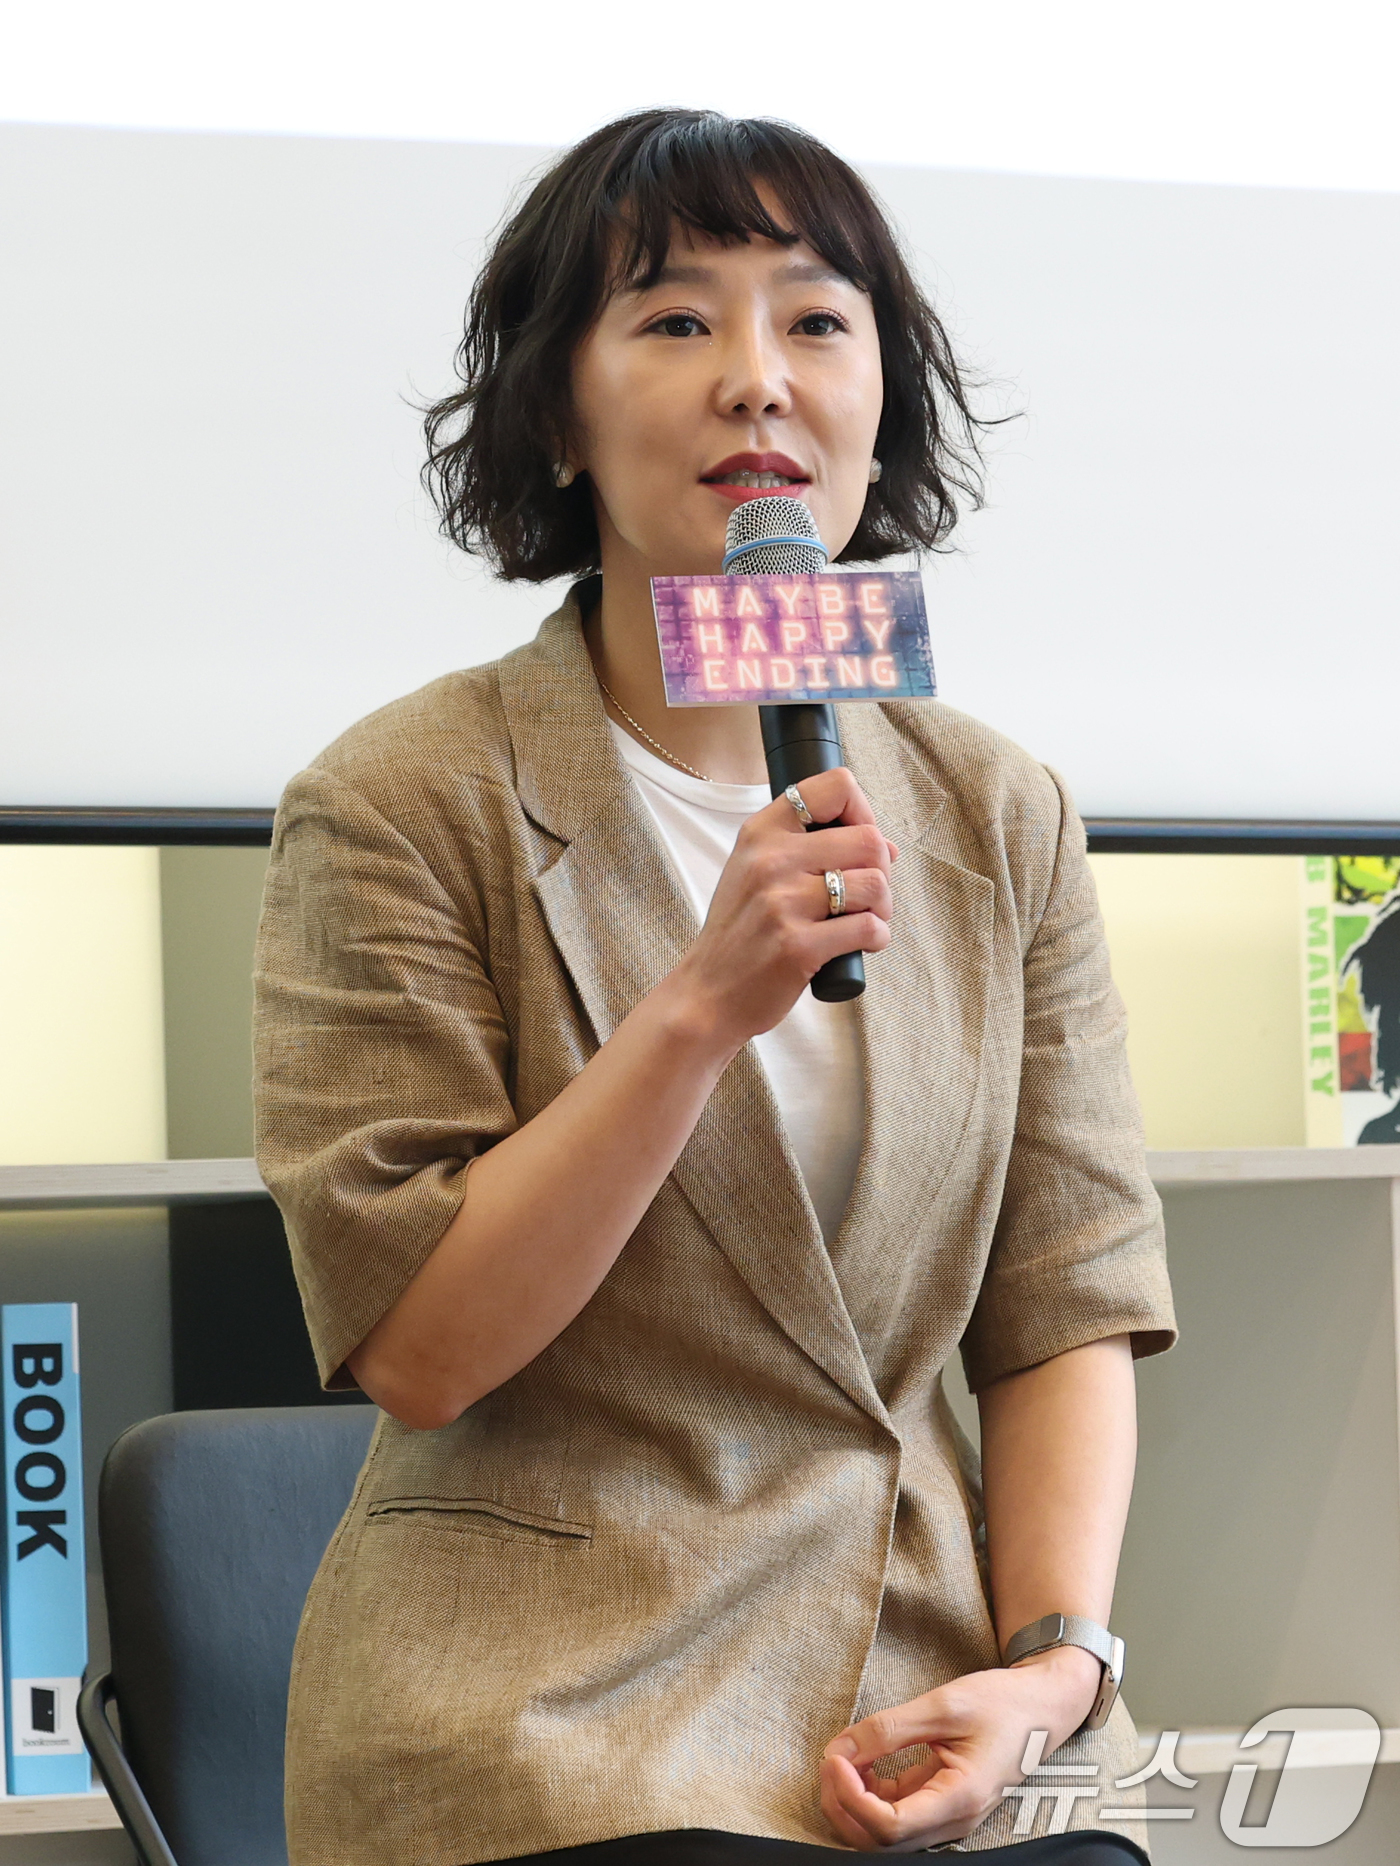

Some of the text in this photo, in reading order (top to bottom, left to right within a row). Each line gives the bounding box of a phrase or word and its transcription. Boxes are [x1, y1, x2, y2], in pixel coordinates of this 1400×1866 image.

[692, 583, 888, 617] MAYBE
[698, 620, 891, 654] HAPPY
[703, 656, 898, 690] ENDING
[1306, 905, 1334, 1097] MARLEY
[12, 1342, 68, 1563] BOOK
